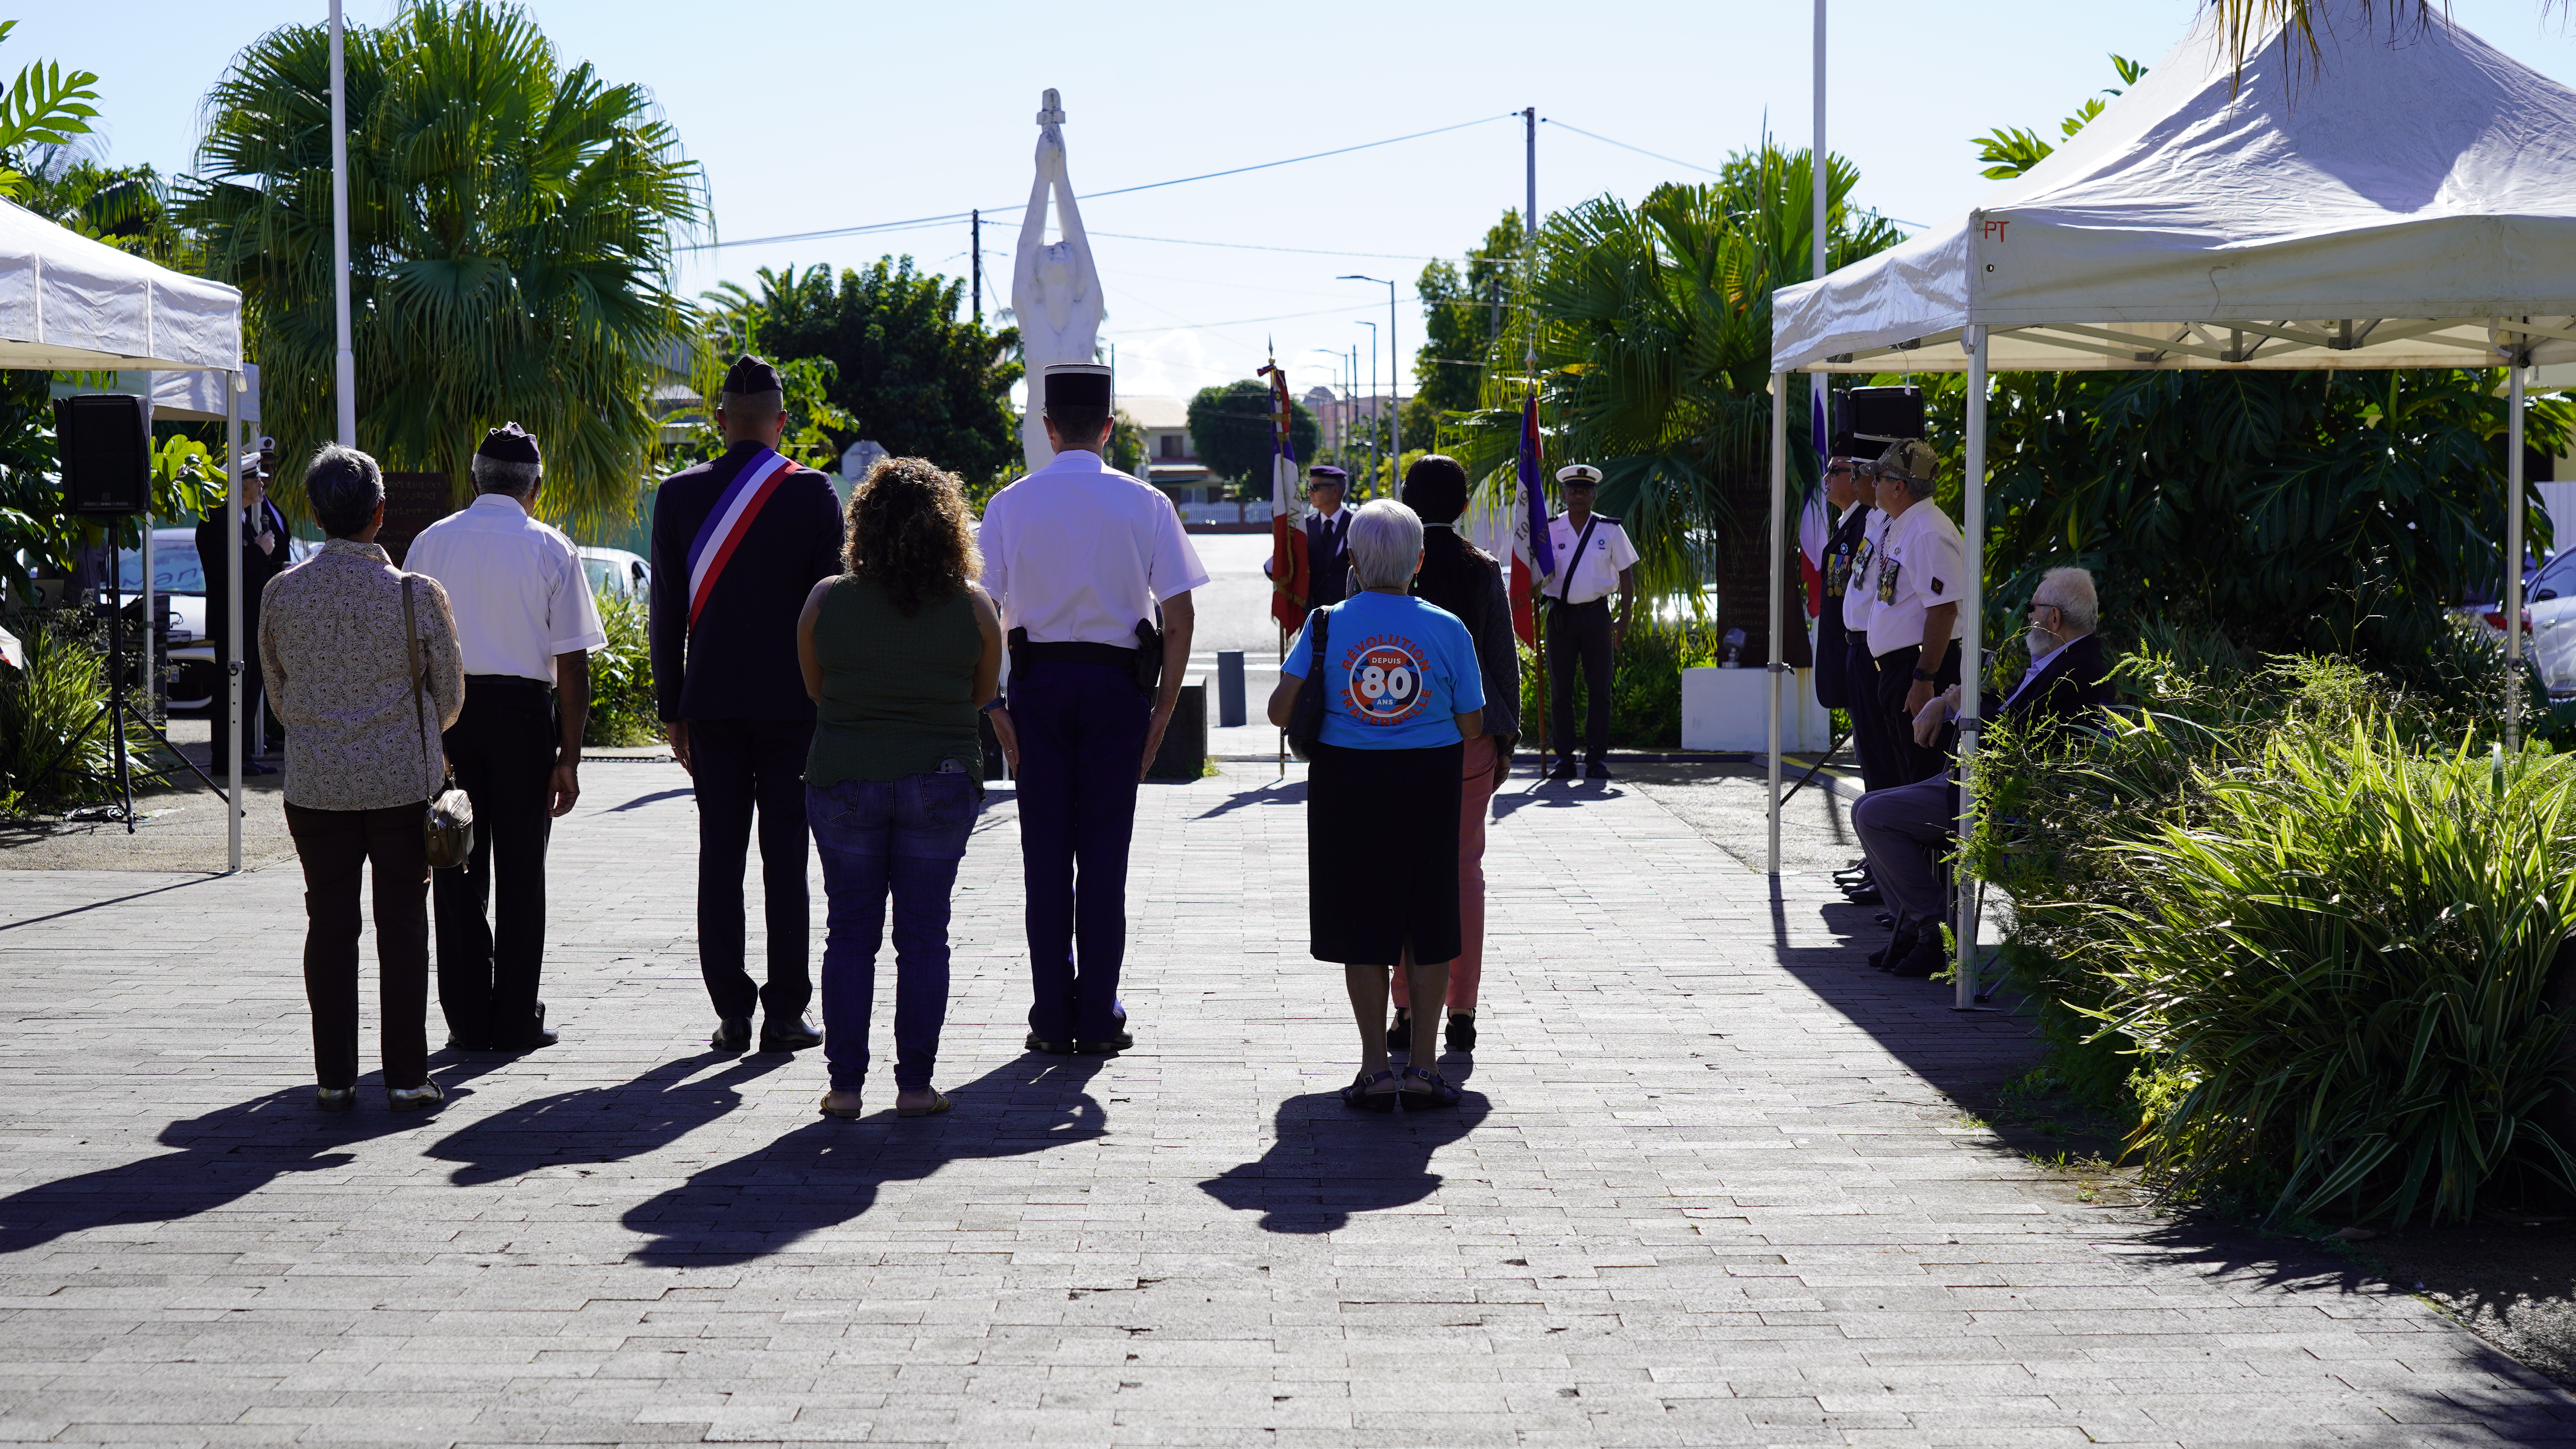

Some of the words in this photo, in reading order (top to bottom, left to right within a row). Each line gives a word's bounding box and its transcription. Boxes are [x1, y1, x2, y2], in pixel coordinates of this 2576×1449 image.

[1985, 220, 2010, 243] PT
[1342, 634, 1431, 672] RÉVOLUTION
[1361, 666, 1412, 699] 80
[1340, 688, 1433, 727] FRATERNELLE
